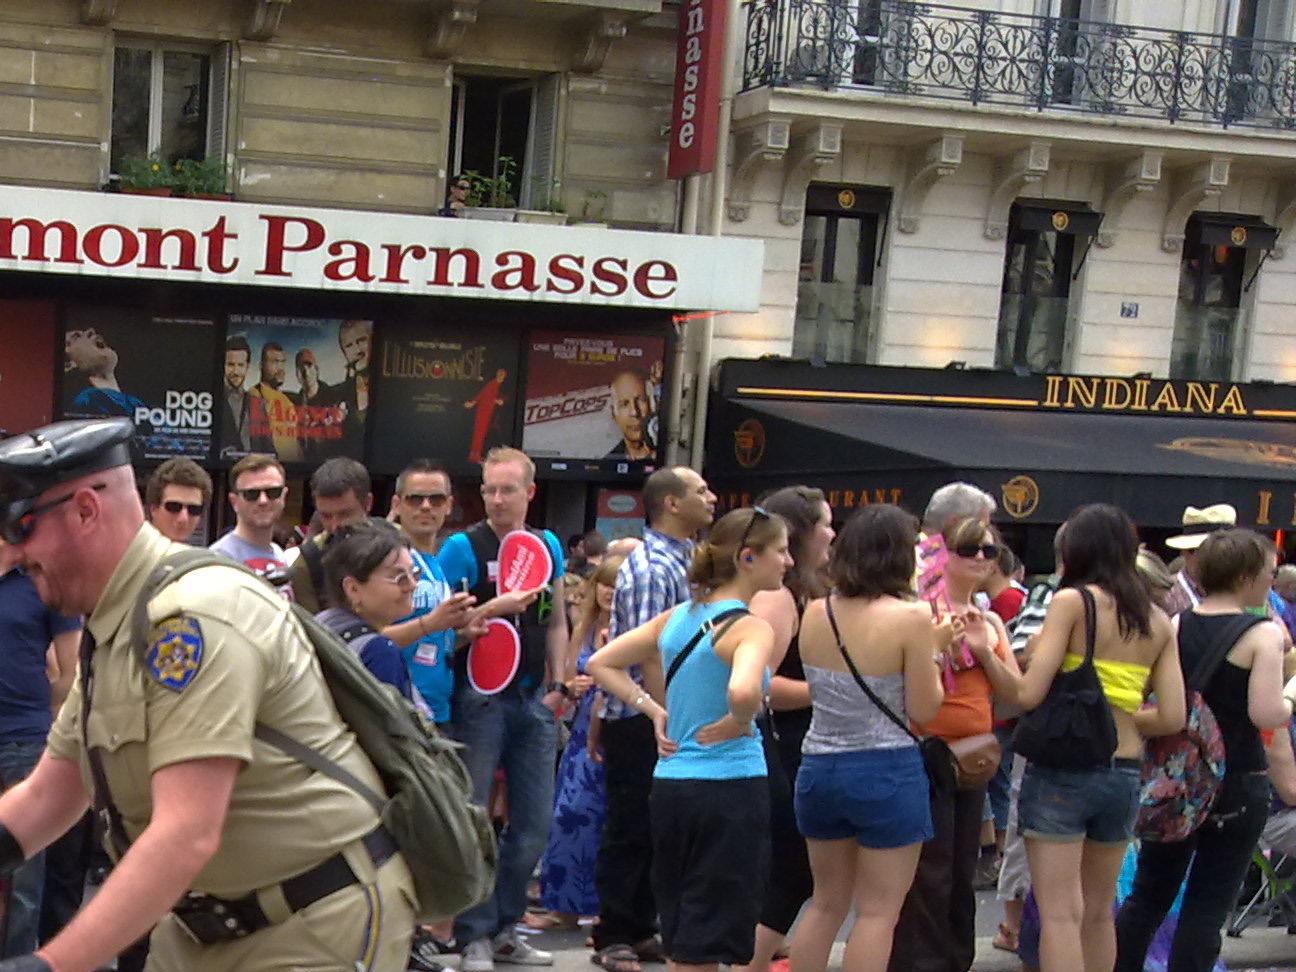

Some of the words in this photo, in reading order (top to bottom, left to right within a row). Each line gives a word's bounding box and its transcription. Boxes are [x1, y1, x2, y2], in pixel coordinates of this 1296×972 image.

[679, 0, 705, 149] nasse
[256, 213, 678, 300] Parnasse
[166, 391, 213, 410] DOG
[1043, 376, 1247, 415] INDIANA
[135, 407, 212, 428] POUND
